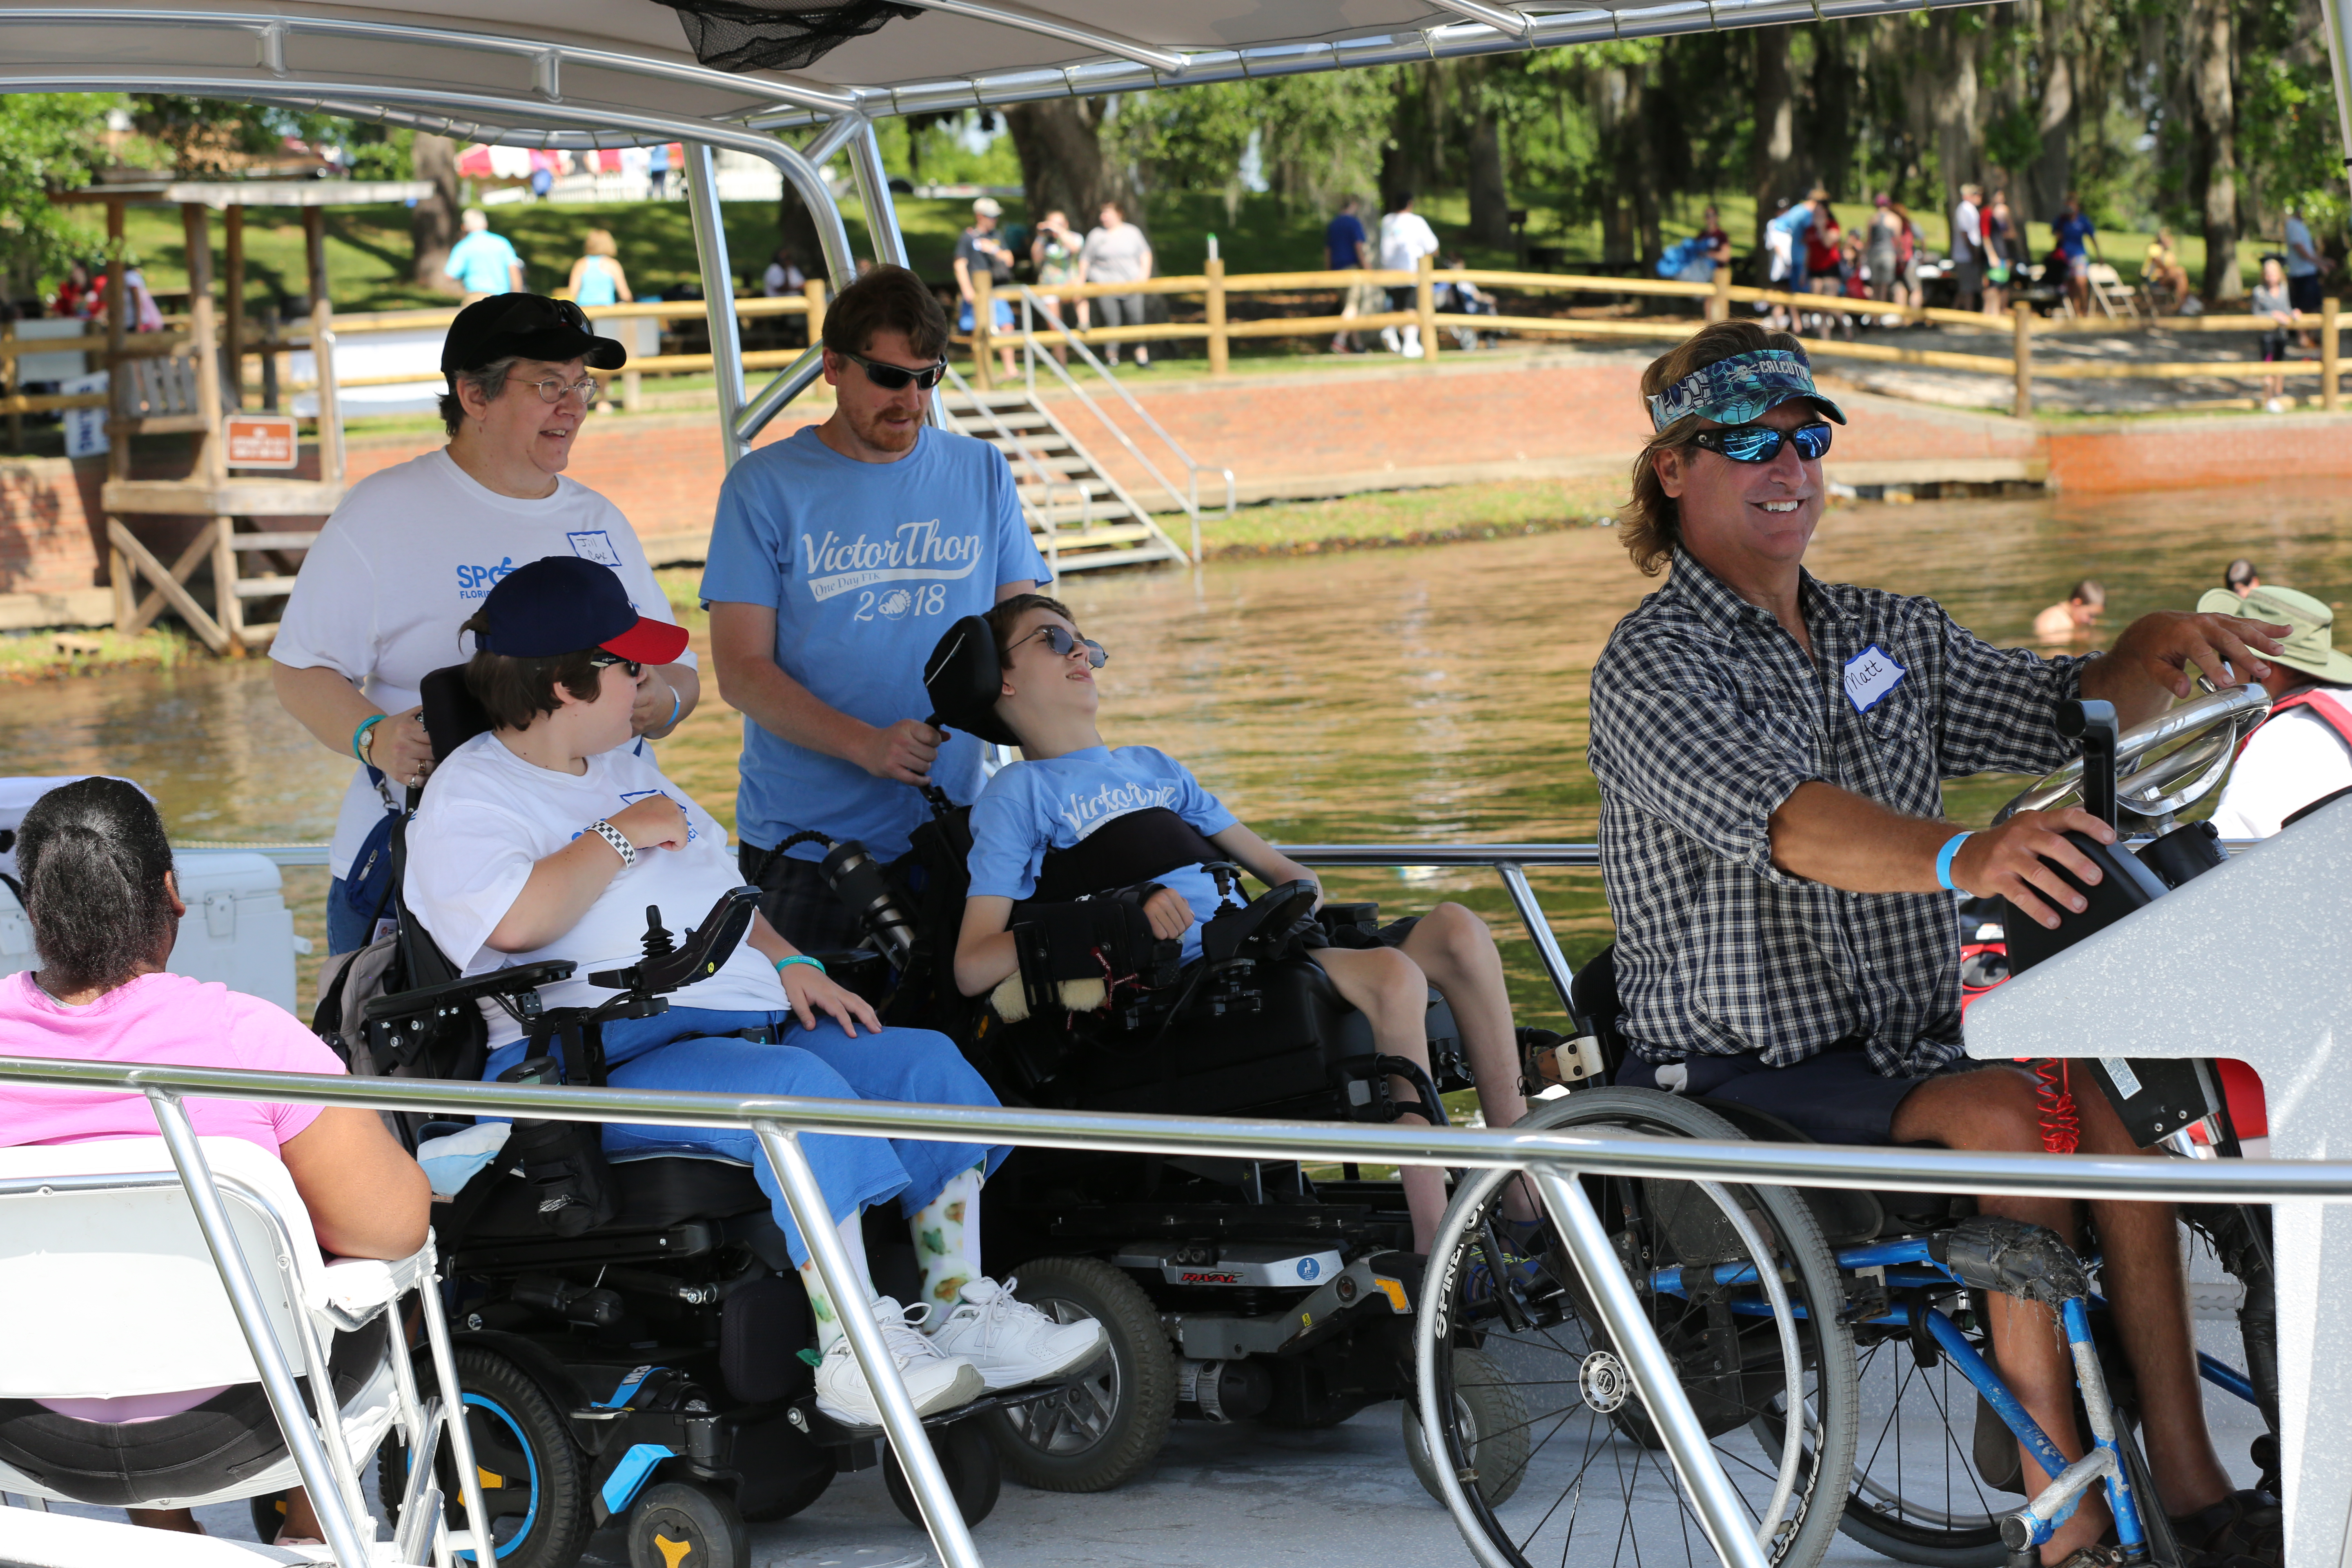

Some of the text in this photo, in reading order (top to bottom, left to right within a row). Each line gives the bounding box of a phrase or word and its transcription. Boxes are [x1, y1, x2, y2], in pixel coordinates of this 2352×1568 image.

[576, 538, 597, 547] Jill
[801, 519, 983, 574] VictorThon
[815, 572, 880, 597] One Day FTK
[1845, 660, 1882, 693] Matt
[1096, 953, 1107, 966] School
[1181, 1273, 1237, 1283] RIVAL
[622, 1365, 652, 1384] M3
